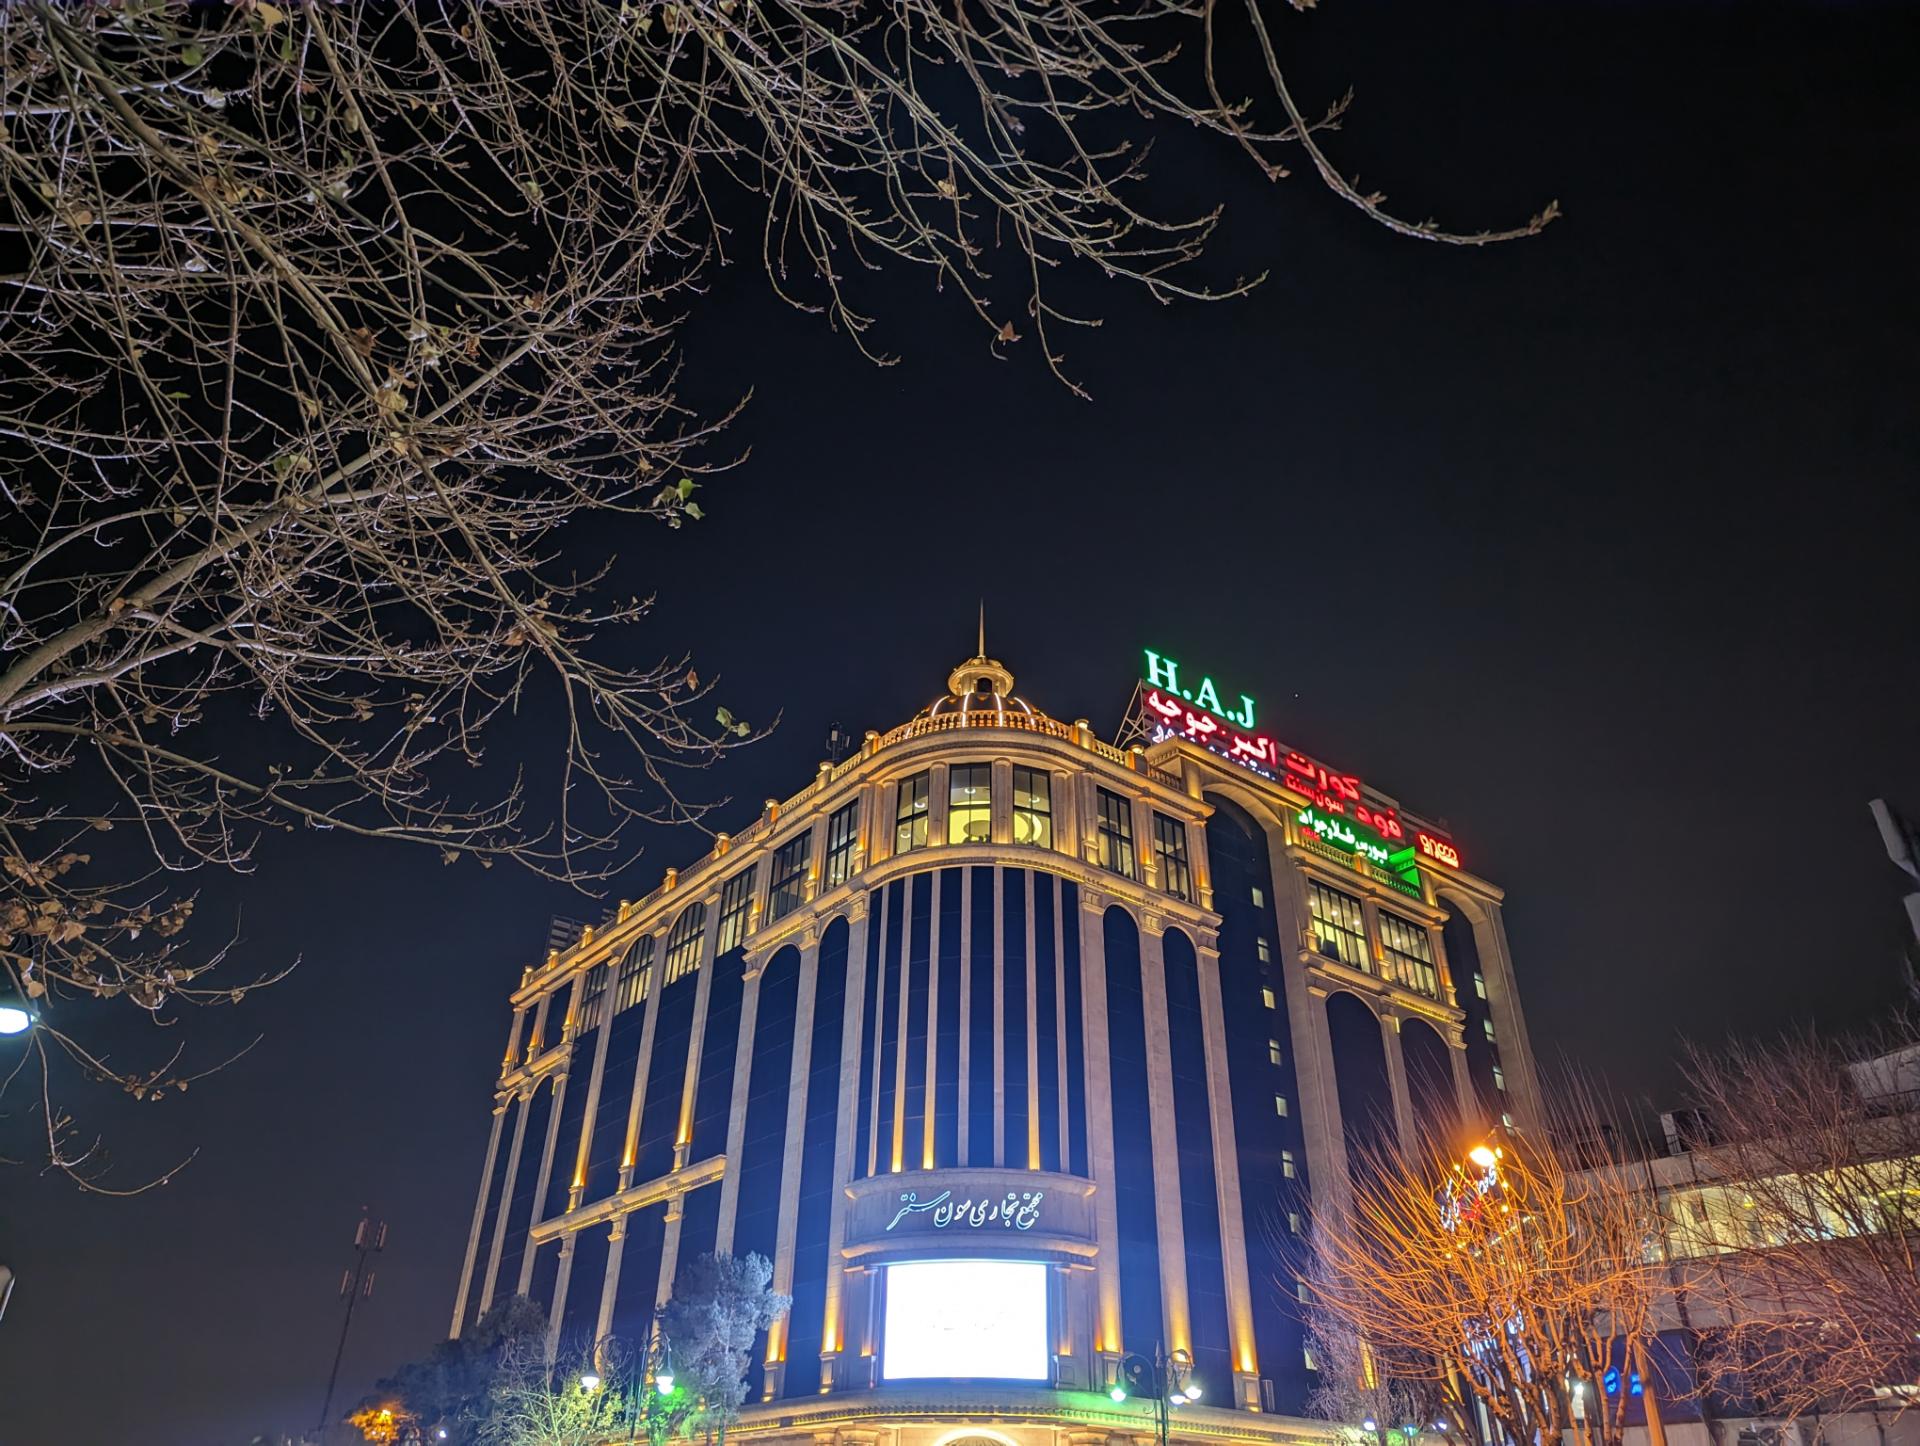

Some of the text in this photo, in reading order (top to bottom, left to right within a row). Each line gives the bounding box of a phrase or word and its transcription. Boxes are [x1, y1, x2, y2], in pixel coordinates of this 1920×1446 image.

[1144, 649, 1255, 729] H.A.J
[1148, 691, 1218, 744] جوجه
[1230, 735, 1277, 766] اکبر
[1286, 752, 1360, 801] کورت
[1357, 806, 1402, 838] فود
[885, 1190, 1044, 1232] مجتمع تجاری سون سنتر
